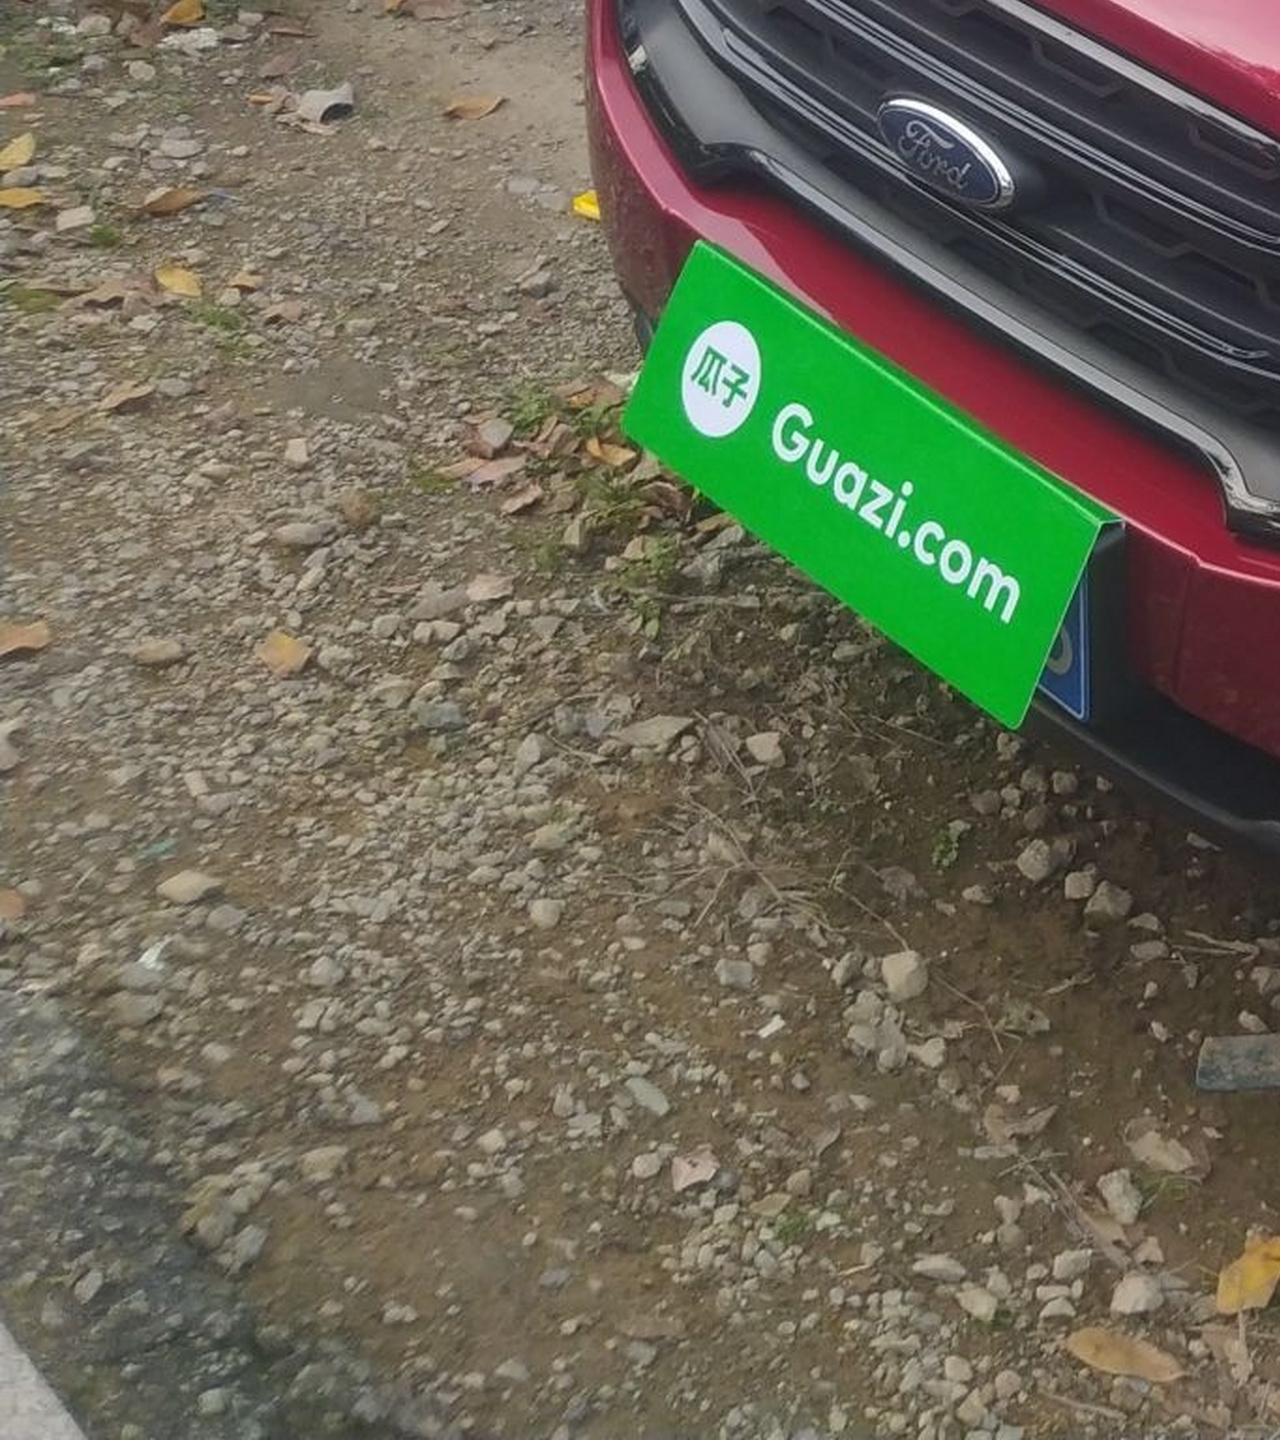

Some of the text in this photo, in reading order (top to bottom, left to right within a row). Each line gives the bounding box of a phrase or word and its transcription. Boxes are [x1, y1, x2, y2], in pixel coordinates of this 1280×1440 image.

[898, 120, 971, 189] Ford
[690, 345, 751, 408] 瓜子
[772, 402, 1020, 623] Guazi.com
